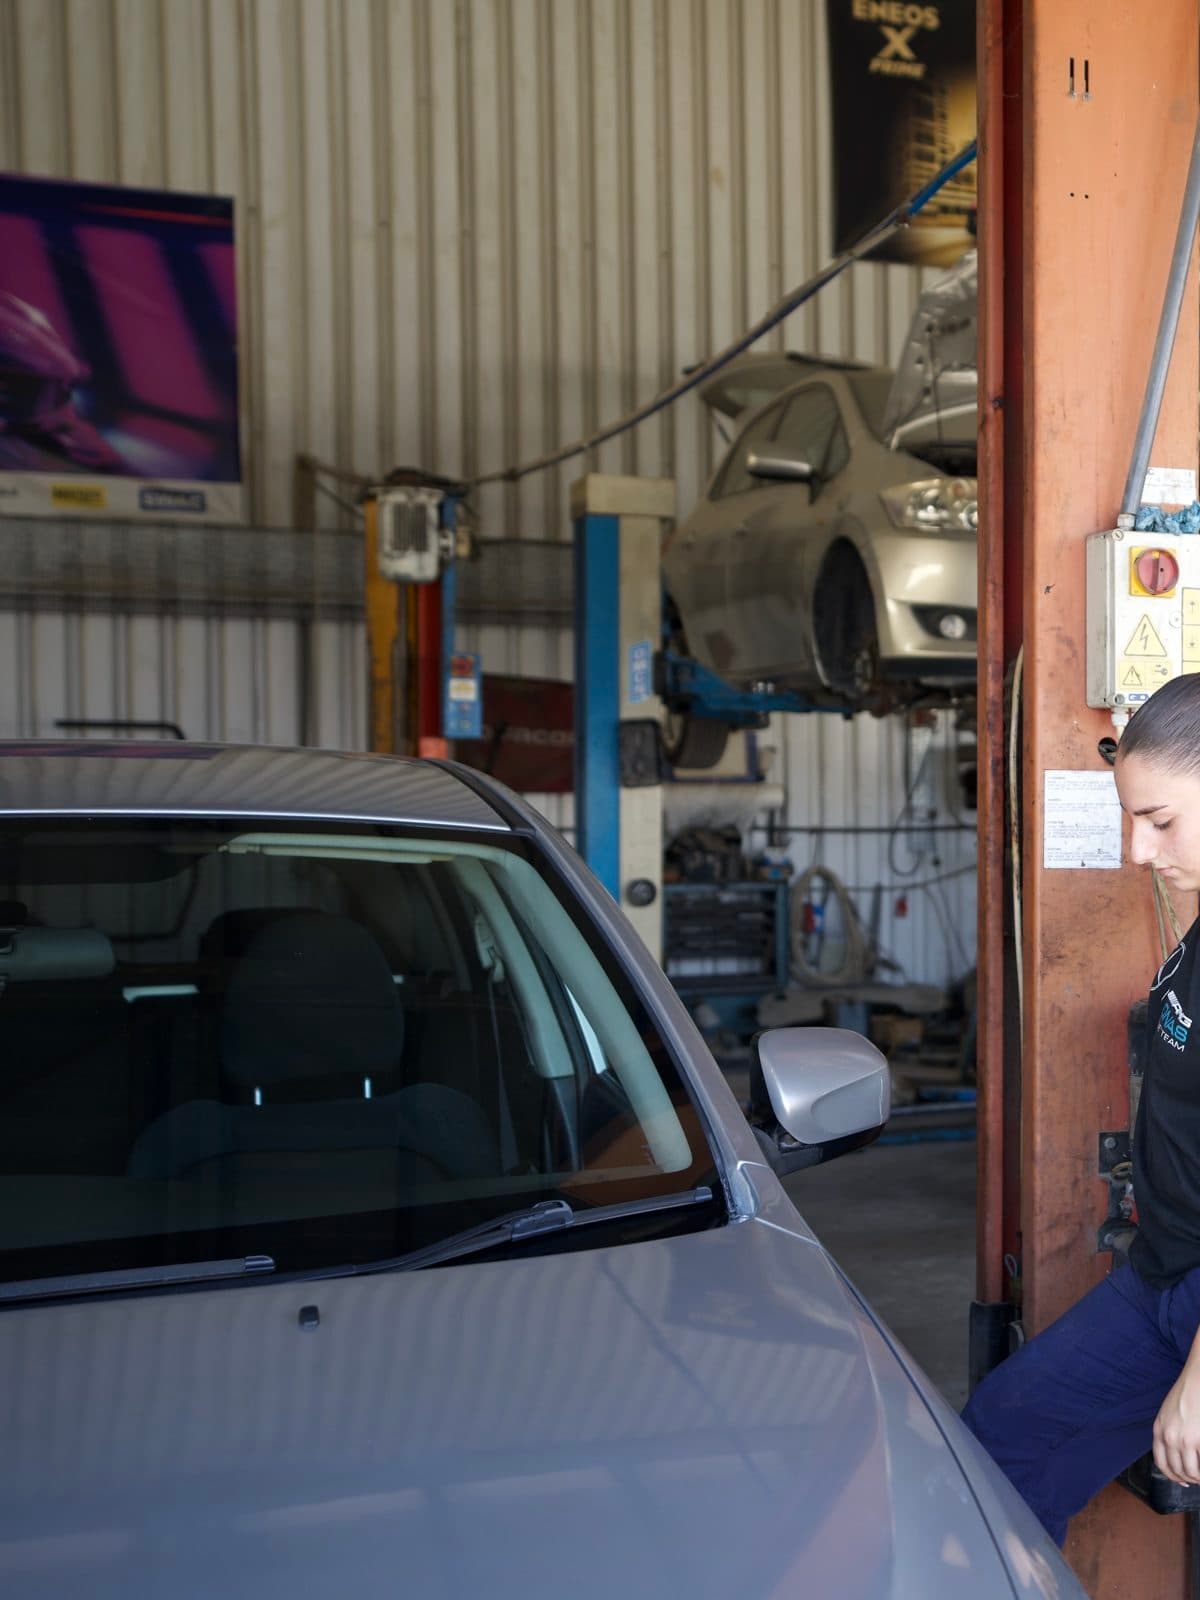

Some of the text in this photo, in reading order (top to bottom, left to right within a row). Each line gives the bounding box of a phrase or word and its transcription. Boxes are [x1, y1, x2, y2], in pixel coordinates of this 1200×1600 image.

[852, 0, 940, 31] ENEOS
[878, 25, 916, 60] X
[1160, 1029, 1186, 1053] TEAM
